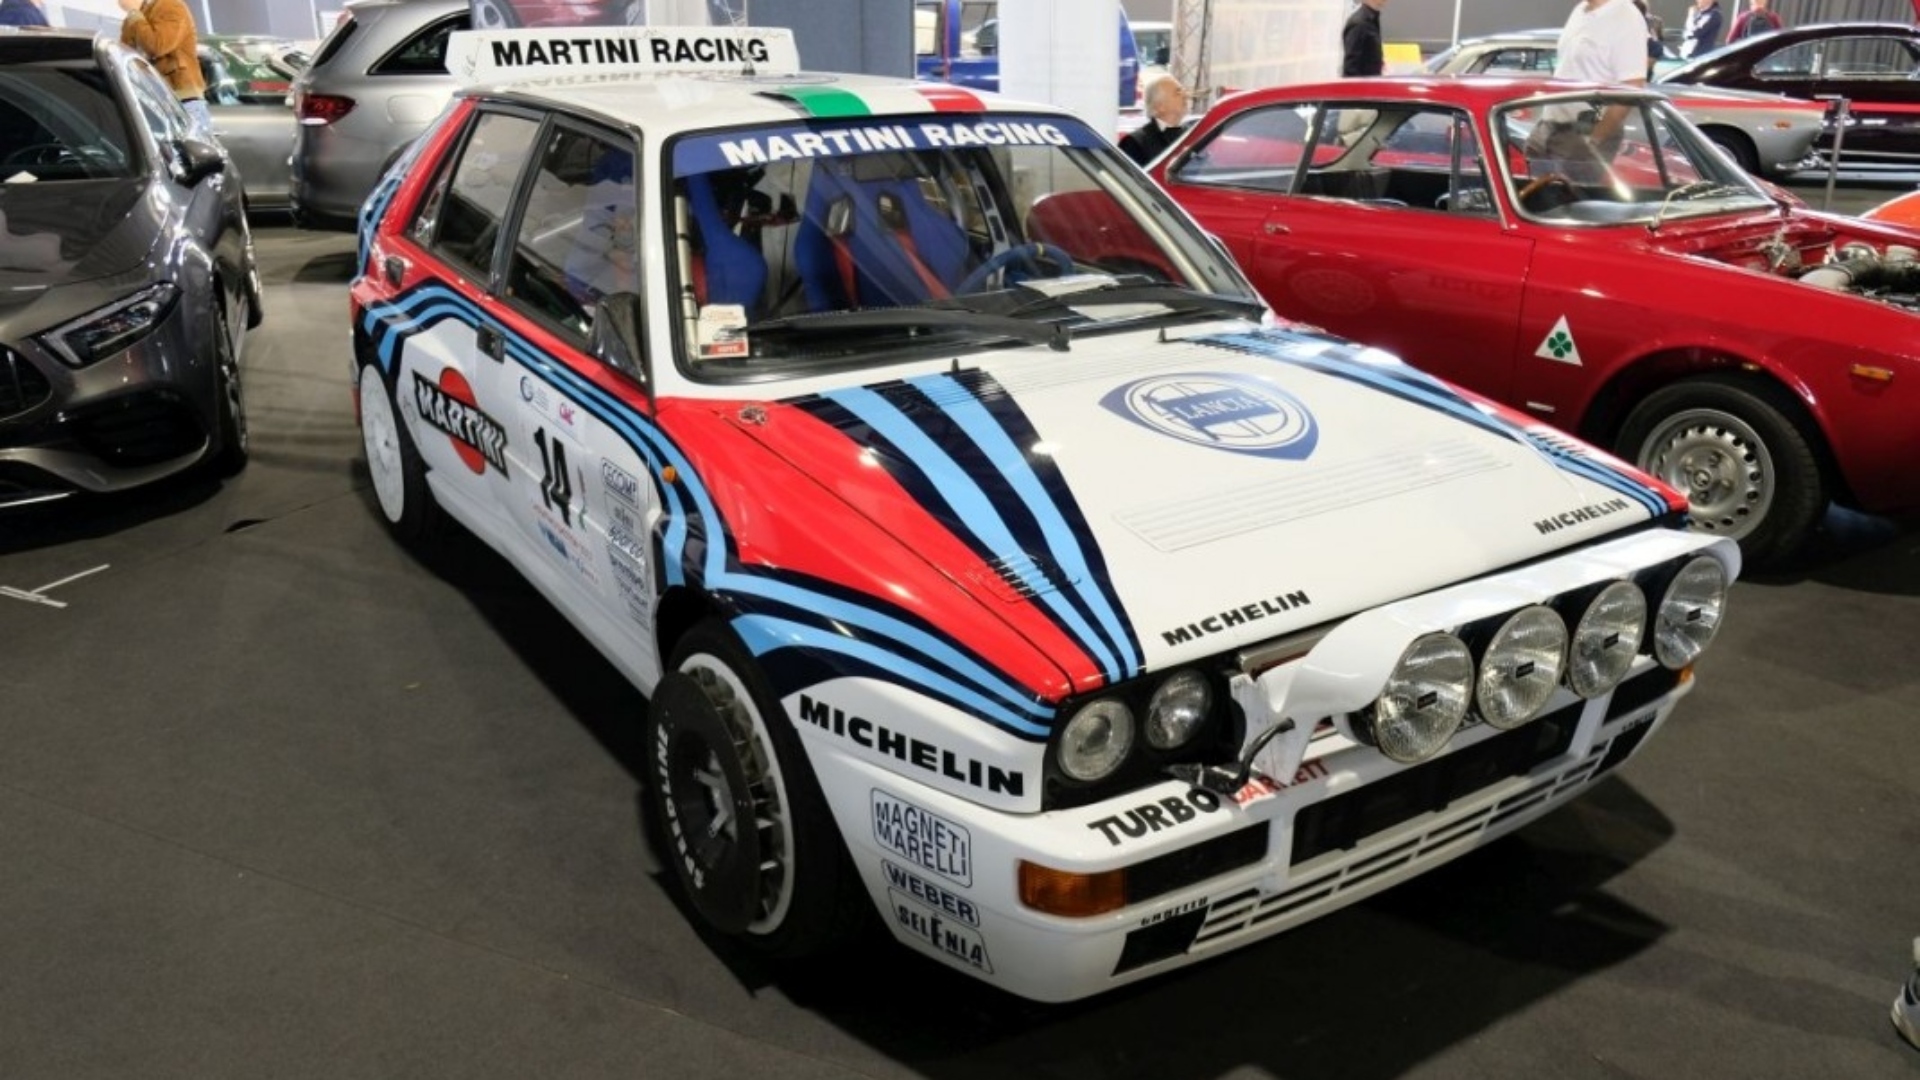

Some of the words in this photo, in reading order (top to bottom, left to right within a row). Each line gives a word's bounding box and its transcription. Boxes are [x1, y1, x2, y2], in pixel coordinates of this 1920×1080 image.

[491, 38, 640, 67] MARTINI
[650, 37, 769, 63] RACING
[719, 125, 916, 167] MARTINI
[919, 122, 1071, 147] RACING
[416, 377, 506, 471] MARTINI
[1174, 395, 1263, 420] LANCIA
[533, 426, 573, 529] 14
[1533, 498, 1629, 535] MICHELIN
[1161, 590, 1311, 647] MICHELIN
[801, 693, 1023, 797] MICHELIN
[876, 802, 966, 858] MAGNETI
[1087, 787, 1221, 846] TURBO
[877, 820, 966, 876] MARELLI
[887, 864, 974, 923] WEBER
